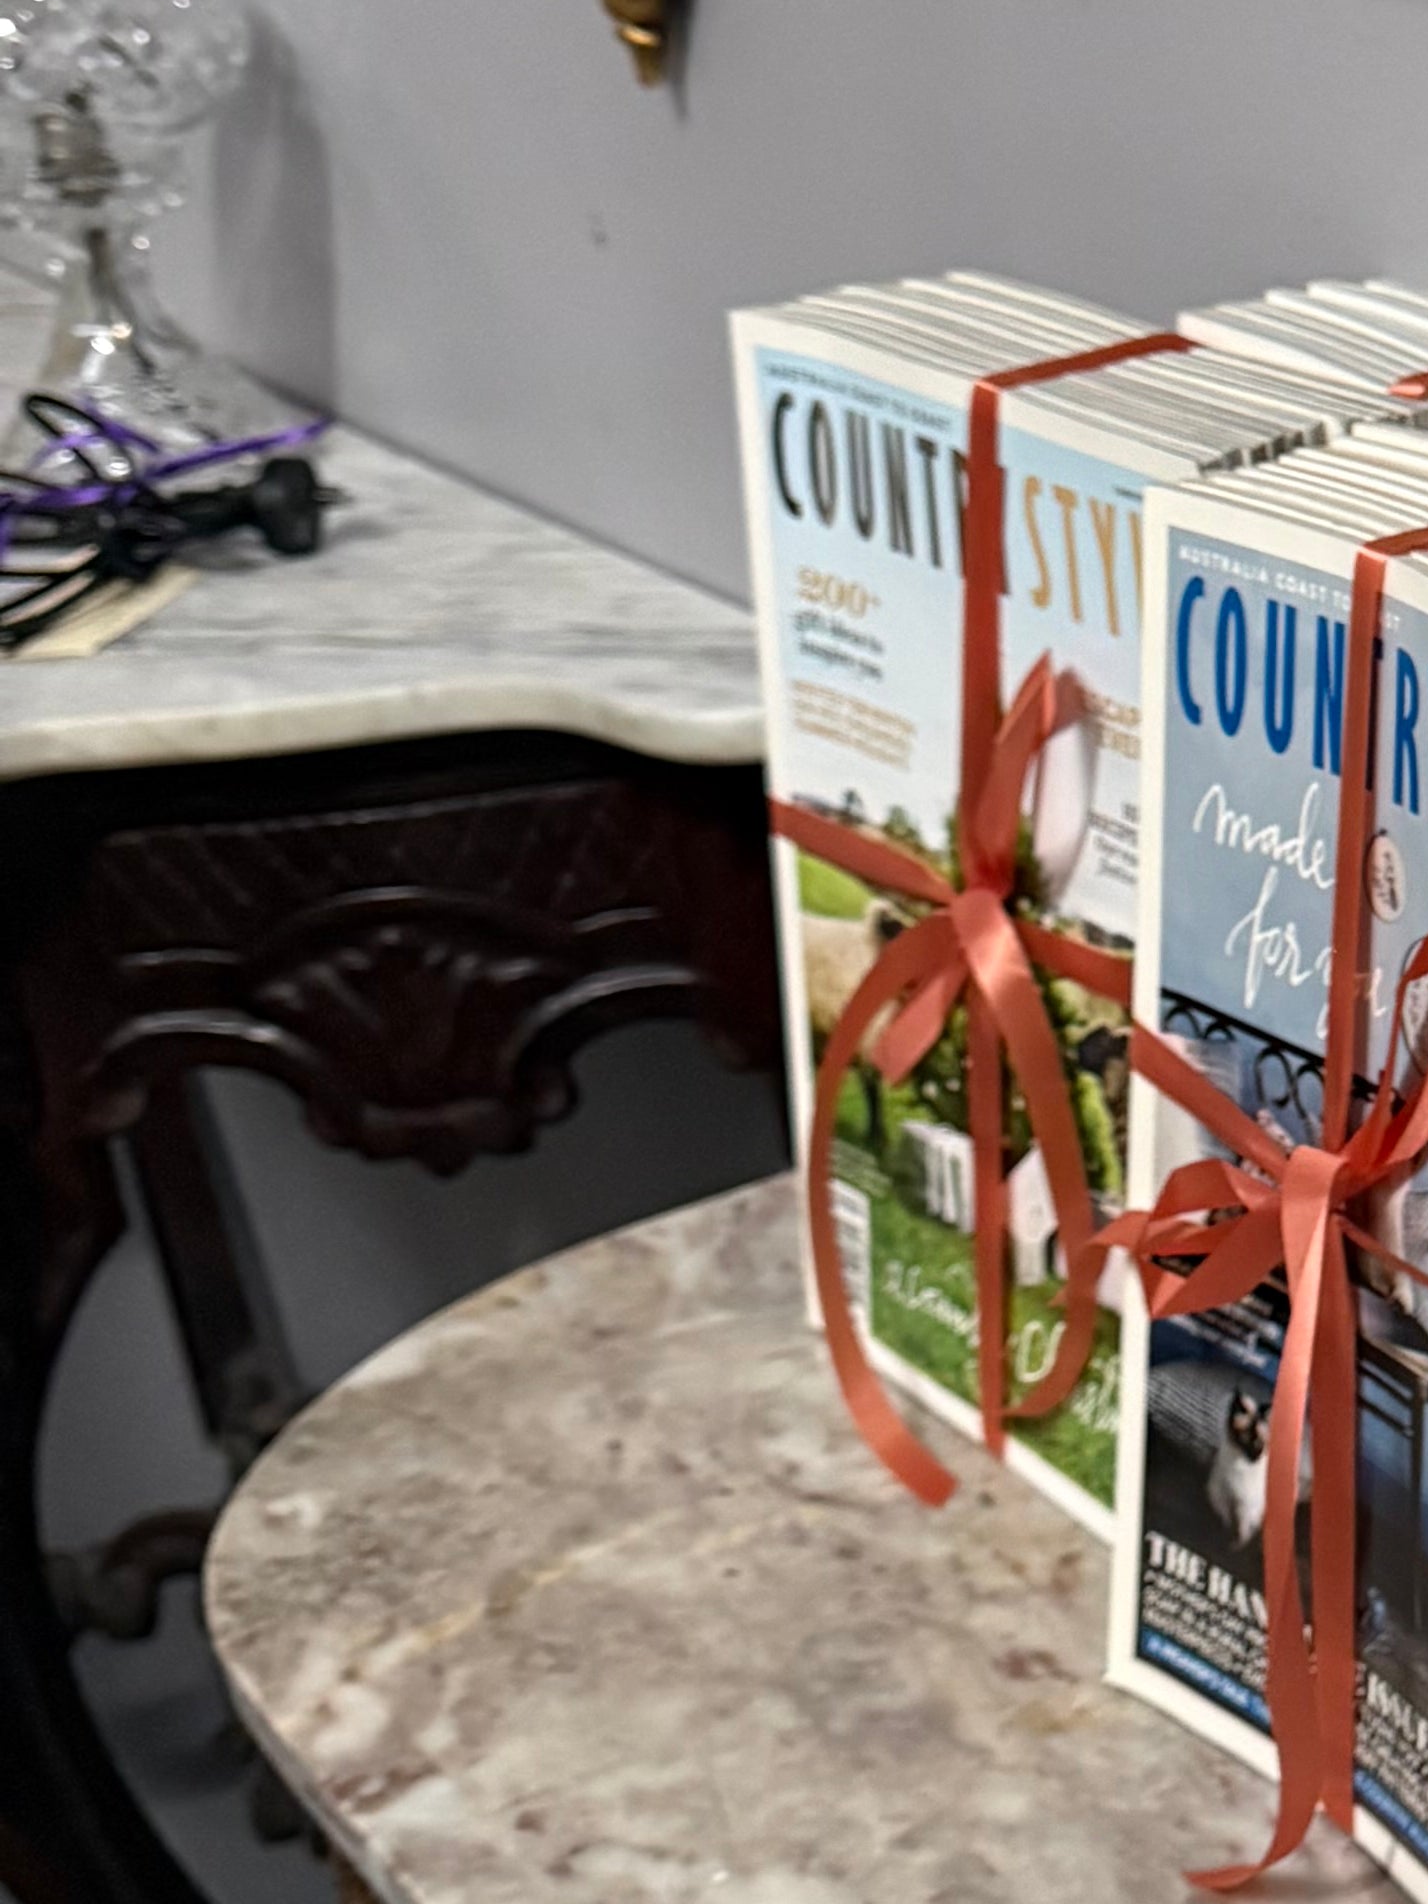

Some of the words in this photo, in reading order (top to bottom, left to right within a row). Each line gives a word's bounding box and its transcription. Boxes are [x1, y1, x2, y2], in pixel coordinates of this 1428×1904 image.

[771, 391, 1009, 595] COUNT
[1178, 544, 1269, 584] AUSTRALIA
[1193, 782, 1336, 890] made
[1144, 1529, 1207, 1590] THE
